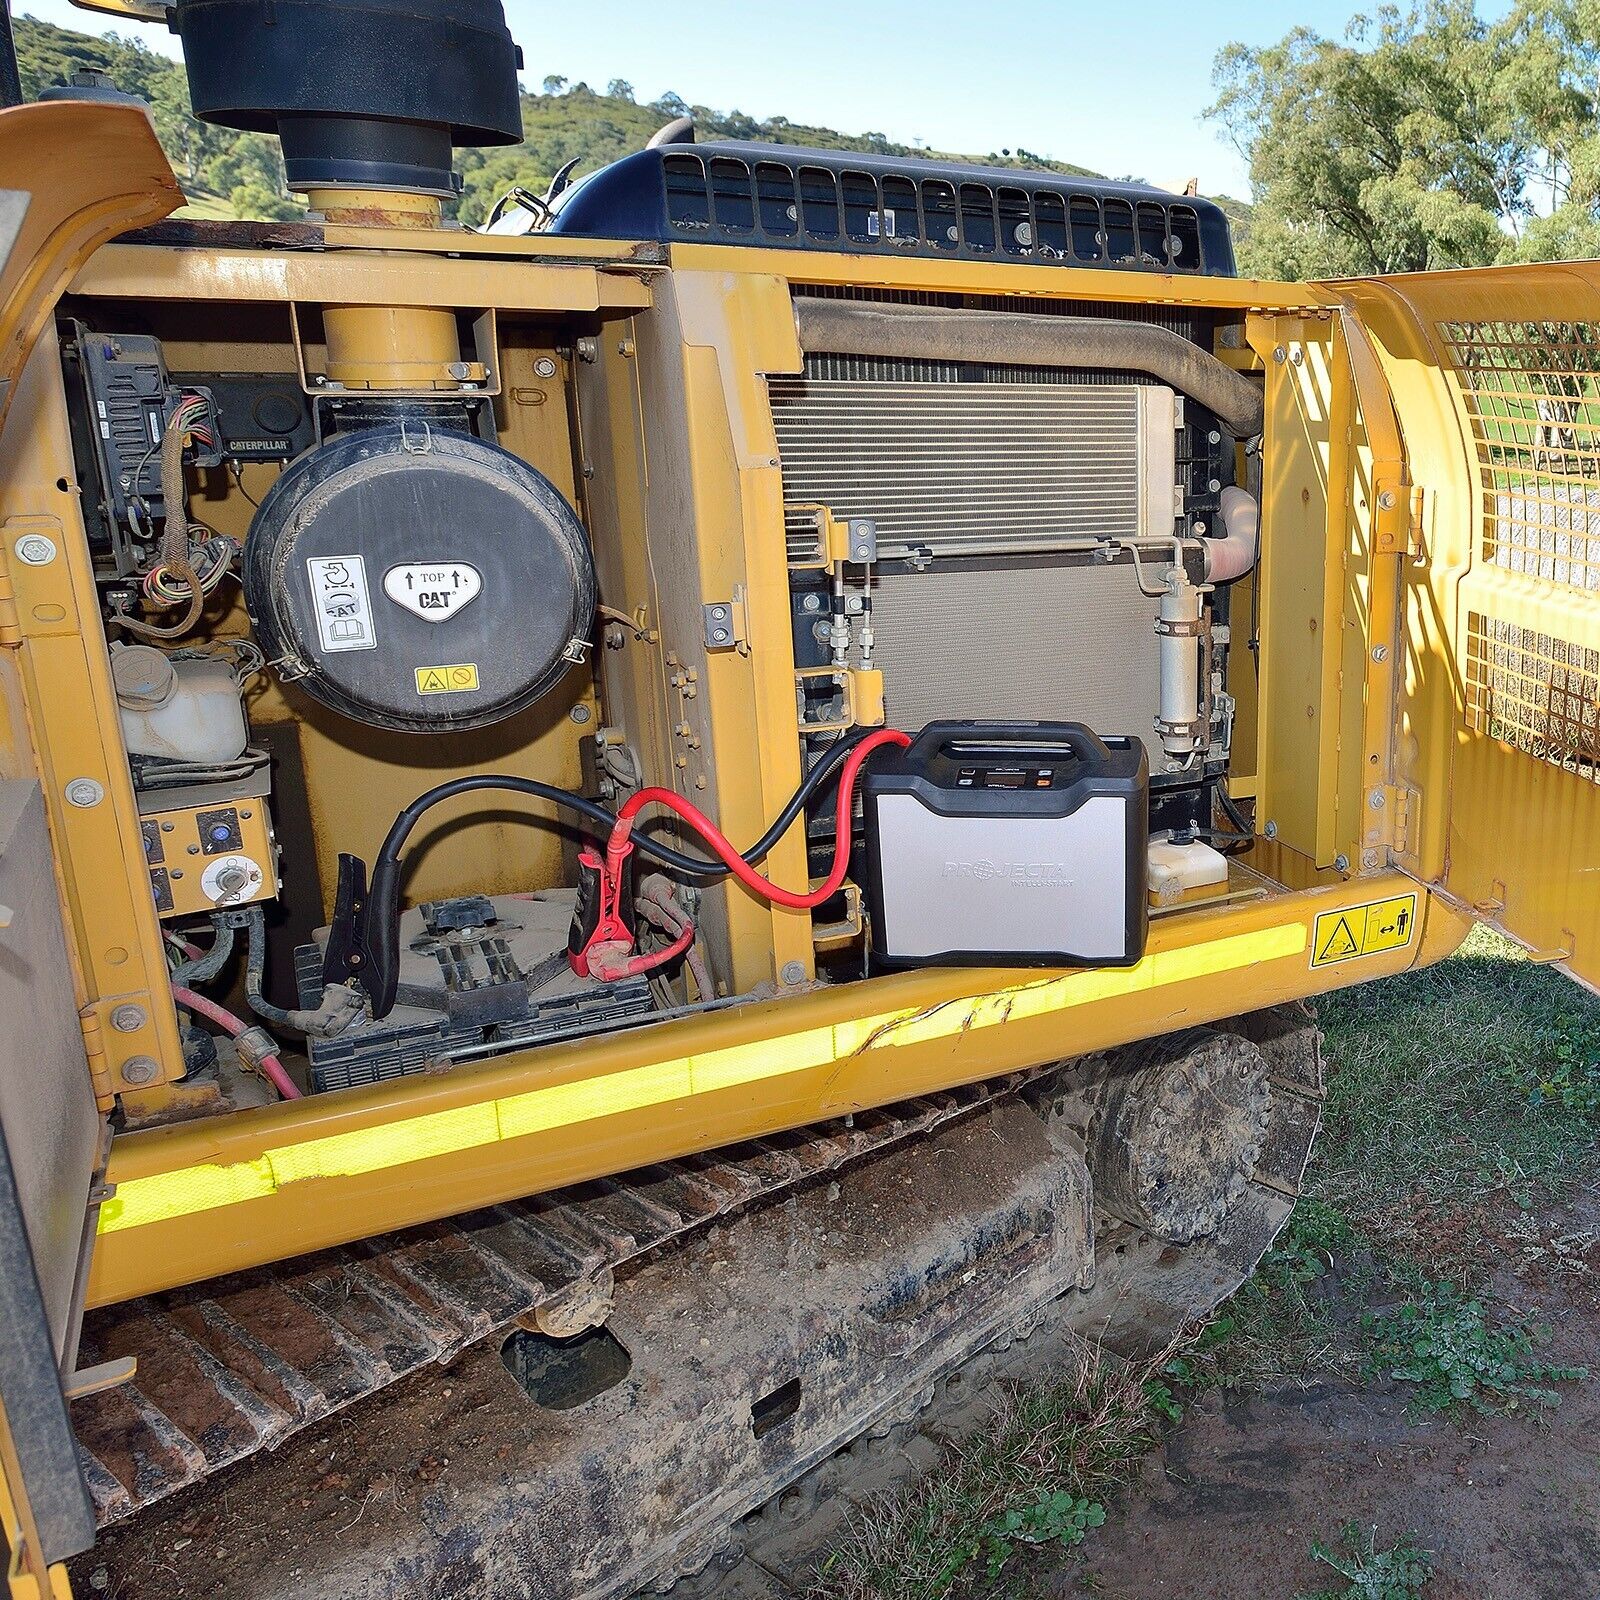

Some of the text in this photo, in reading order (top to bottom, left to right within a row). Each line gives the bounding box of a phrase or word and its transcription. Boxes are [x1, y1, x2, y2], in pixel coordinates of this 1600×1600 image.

[229, 440, 287, 450] CATERPILLAR
[420, 573, 445, 582] TOP
[419, 591, 451, 608] CAT
[942, 858, 1066, 881] PROJECTA
